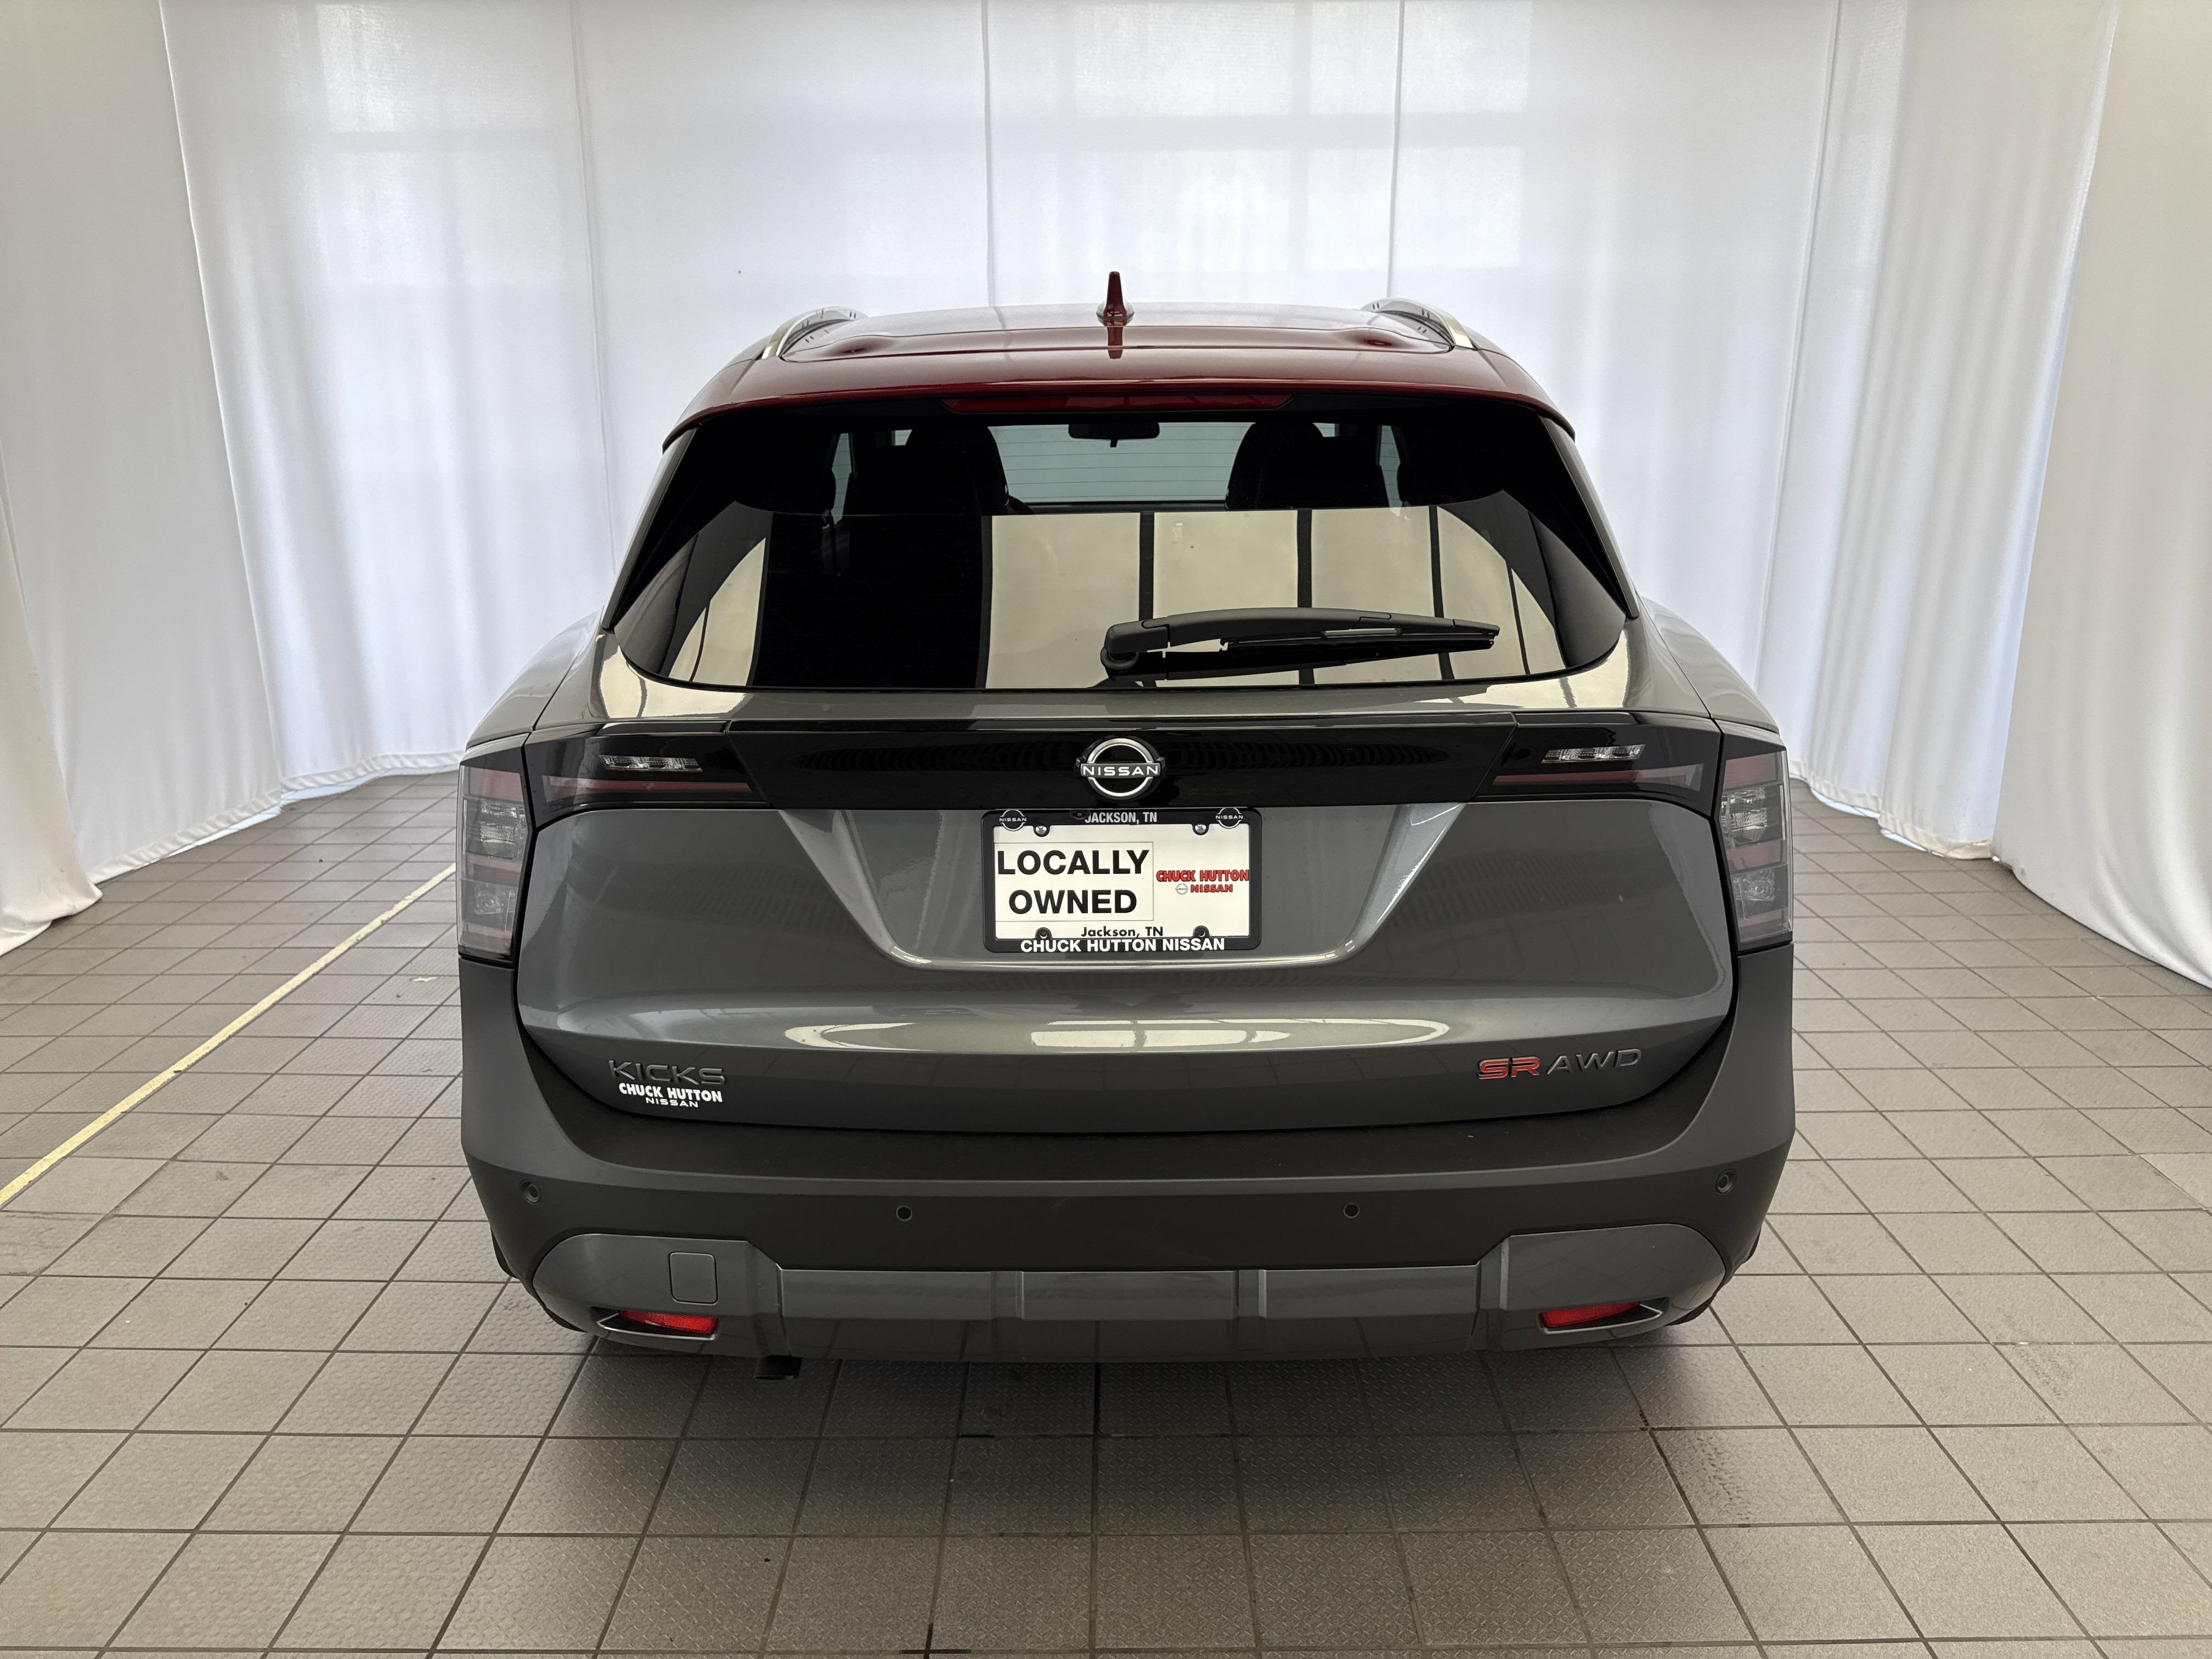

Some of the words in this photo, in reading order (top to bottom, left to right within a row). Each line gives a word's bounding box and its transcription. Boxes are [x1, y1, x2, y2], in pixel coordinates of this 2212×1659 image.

[1083, 766, 1158, 776] NISSAN
[1085, 812, 1139, 825] JACKSON,
[1143, 812, 1157, 822] TN
[997, 850, 1149, 875] LOCALLY
[1156, 870, 1196, 882] CHUCK
[1199, 870, 1249, 881] HUTTON
[1190, 884, 1233, 893] NISSAN
[1009, 889, 1137, 914] OWNED
[1081, 926, 1140, 938] Jackson,
[1146, 927, 1163, 936] TN
[1020, 939, 1082, 952] CHUCK
[1087, 939, 1159, 952] HUTTON
[1163, 938, 1224, 951] NISSAN
[1479, 1057, 1540, 1079] SR
[1547, 1049, 1641, 1074] AWD
[608, 1060, 725, 1085] KICKS
[619, 1083, 663, 1098] CHUCK
[667, 1088, 723, 1102] HUTTON
[646, 1097, 698, 1108] NISSAN
